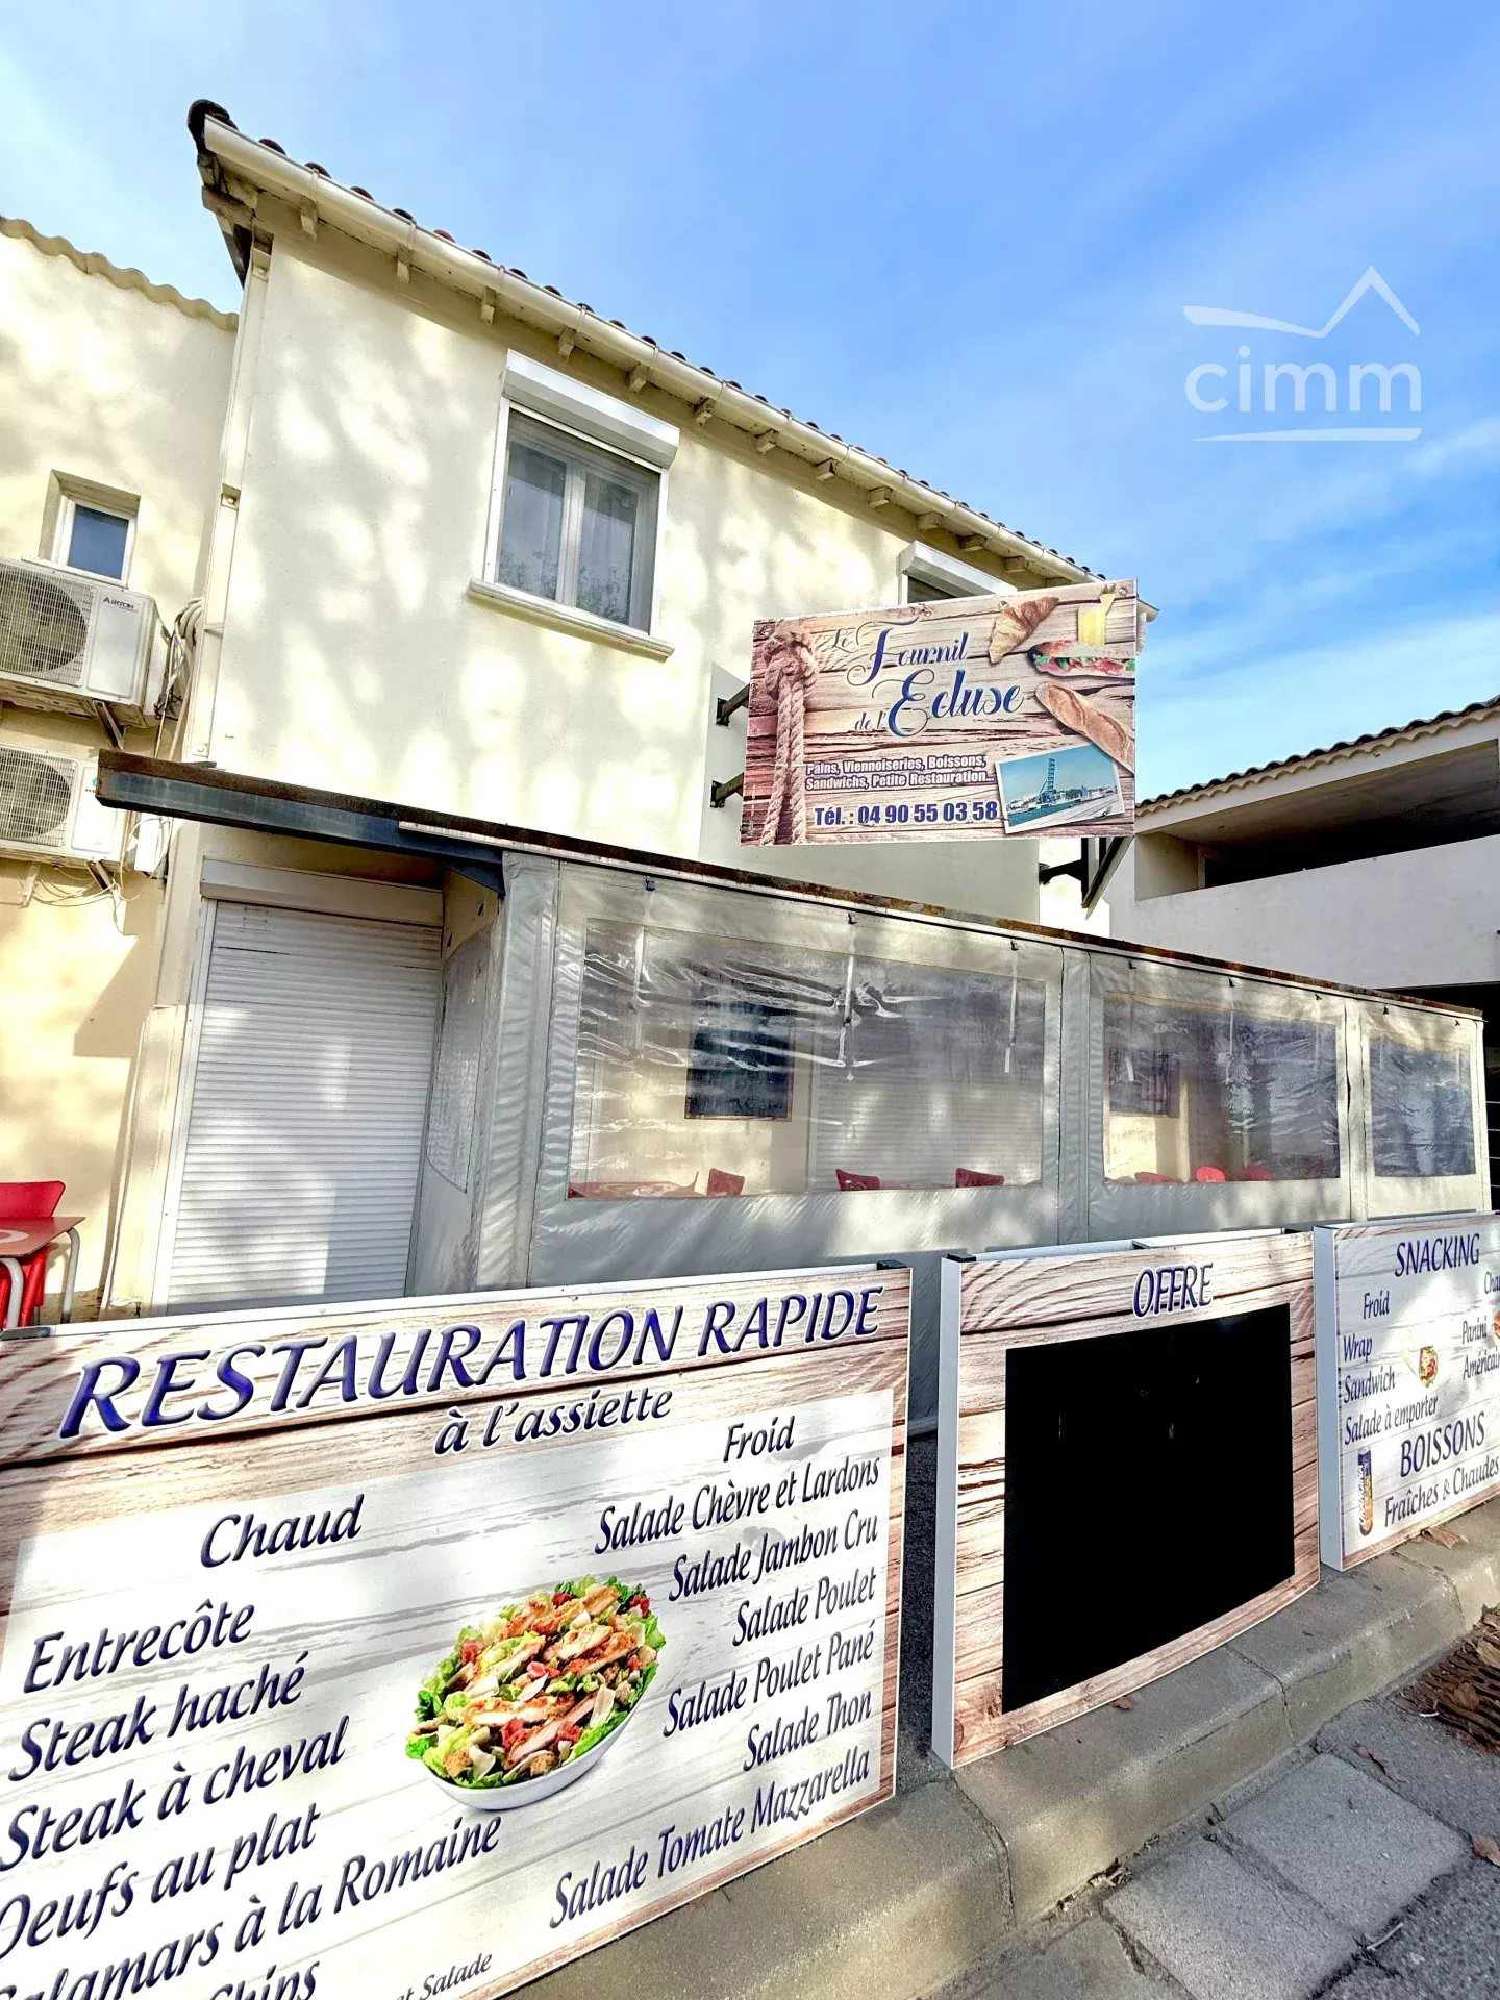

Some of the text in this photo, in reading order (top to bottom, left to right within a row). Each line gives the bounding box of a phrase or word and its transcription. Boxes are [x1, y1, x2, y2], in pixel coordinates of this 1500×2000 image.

[847, 616, 969, 686] Fournil
[854, 711, 872, 731] de
[805, 769, 996, 791] Sandwichs, Petite Restauration...
[806, 755, 987, 776] Pains, Viennoiseries, Boissons,
[857, 805, 881, 825] 04
[884, 804, 909, 824] 90
[914, 803, 939, 823] 55
[943, 802, 968, 822] 03
[972, 801, 998, 821] 58
[1395, 1233, 1480, 1278] SNACKING
[1133, 1263, 1213, 1318] OFFRE
[1363, 1290, 1391, 1320] Froid
[58, 1286, 884, 1439] RESTAURATION RAPIDE
[1343, 1333, 1373, 1363] Wrap
[1462, 1315, 1487, 1345] Panini
[1344, 1366, 1396, 1404] Sandwich
[434, 1388, 673, 1455] à l'assiette
[723, 1416, 796, 1463] Froid
[1345, 1409, 1382, 1446] Salade
[1394, 1395, 1439, 1429] emporter
[1401, 1410, 1485, 1477] BOISSONS
[594, 1456, 880, 1555] Salade Chèvre et Lardons
[1384, 1483, 1440, 1527] Fraîches
[1453, 1454, 1500, 1495] Chaudes
[200, 1494, 365, 1569] Chaud
[669, 1509, 878, 1602] Salade Jambon Cru
[732, 1567, 877, 1647] Salade Poulet
[23, 1598, 256, 1695] Entrecôte
[663, 1619, 876, 1737] Salade Poulet Pané
[7, 1651, 308, 1782] Steak haché
[743, 1690, 872, 1772] Salade Thon
[0, 1715, 350, 1872] Steak à cheval
[151, 1846, 216, 1904] au
[223, 1802, 321, 1892] plat
[549, 1745, 871, 1929] Salade Tomate Mazzarella
[0, 1816, 502, 2000] lamars à la Romaine
[418, 1952, 493, 2000] Salade
